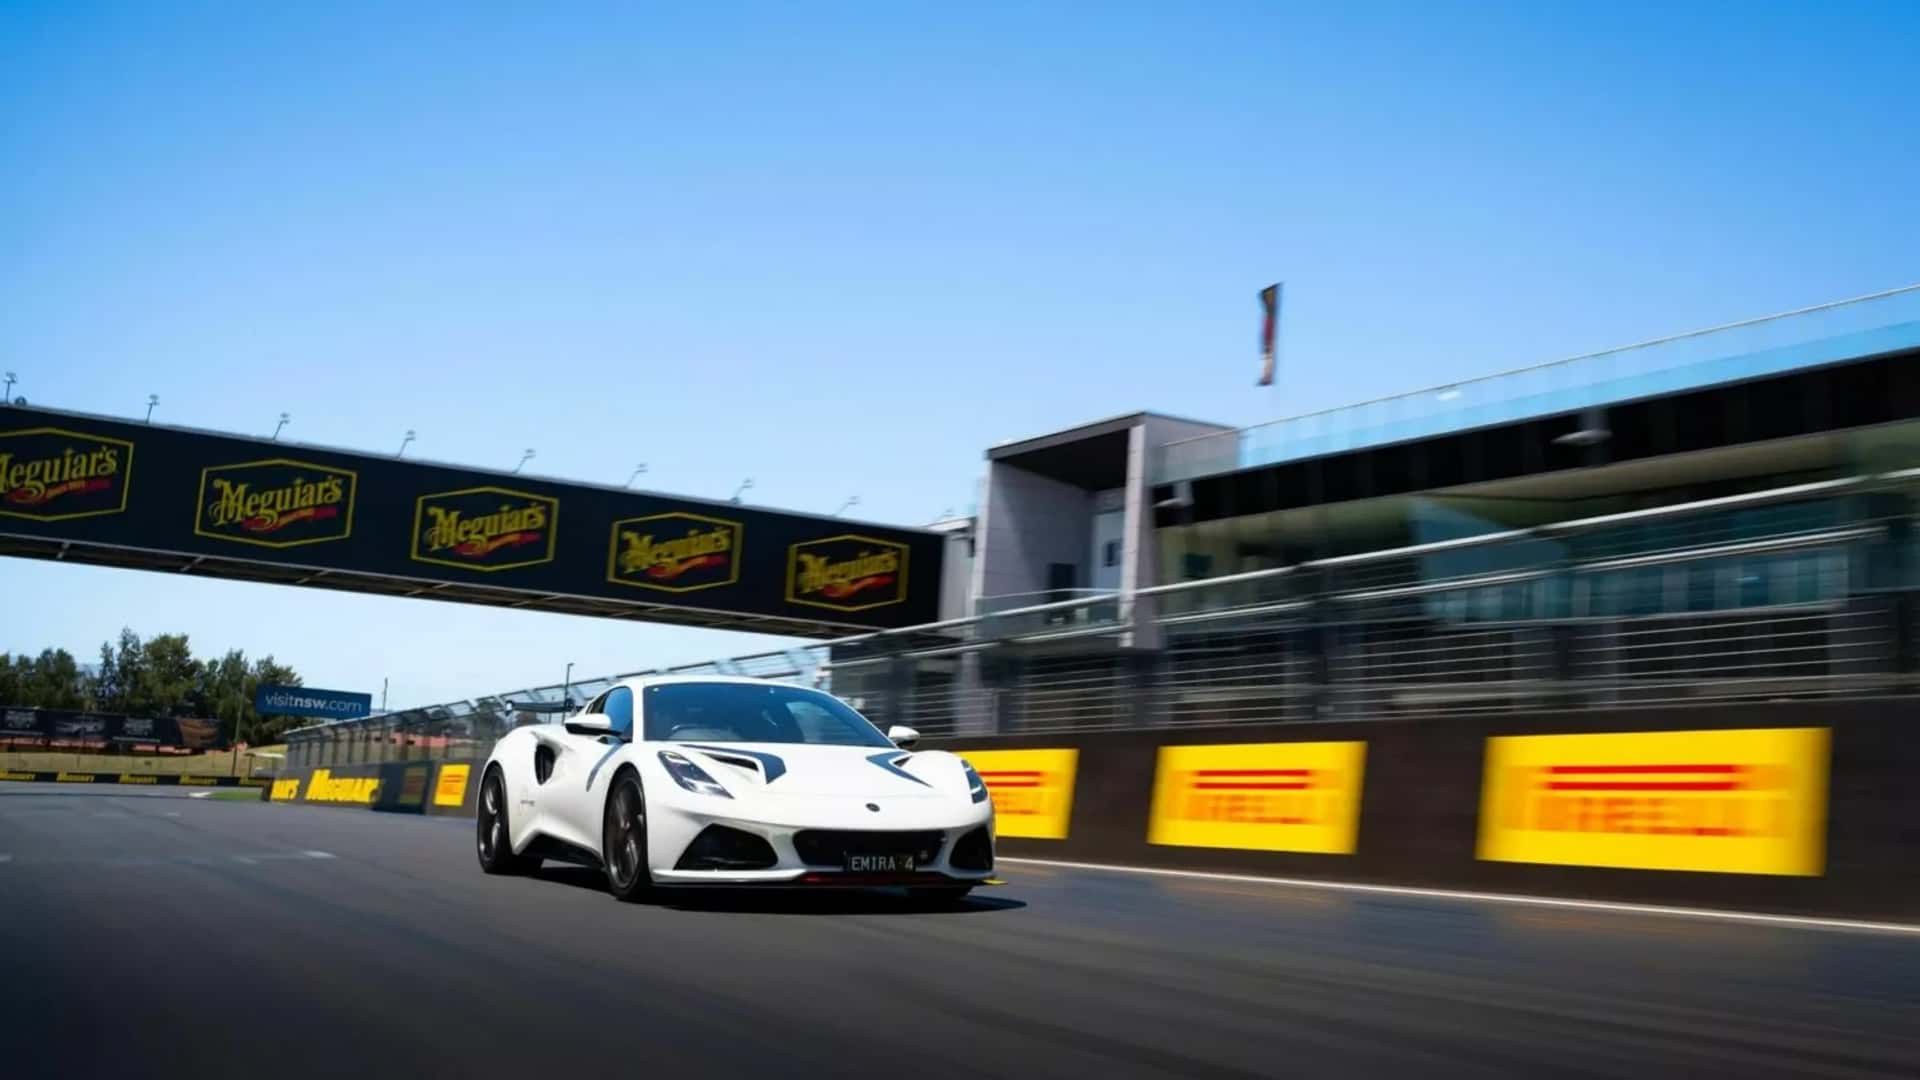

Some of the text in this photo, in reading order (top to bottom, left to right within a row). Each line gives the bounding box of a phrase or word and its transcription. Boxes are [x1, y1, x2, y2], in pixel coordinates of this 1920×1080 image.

[208, 475, 343, 527] Meguiar's
[424, 502, 546, 552] Meguiar's
[264, 691, 363, 713] visitnsw.com
[851, 855, 897, 872] EMIRA
